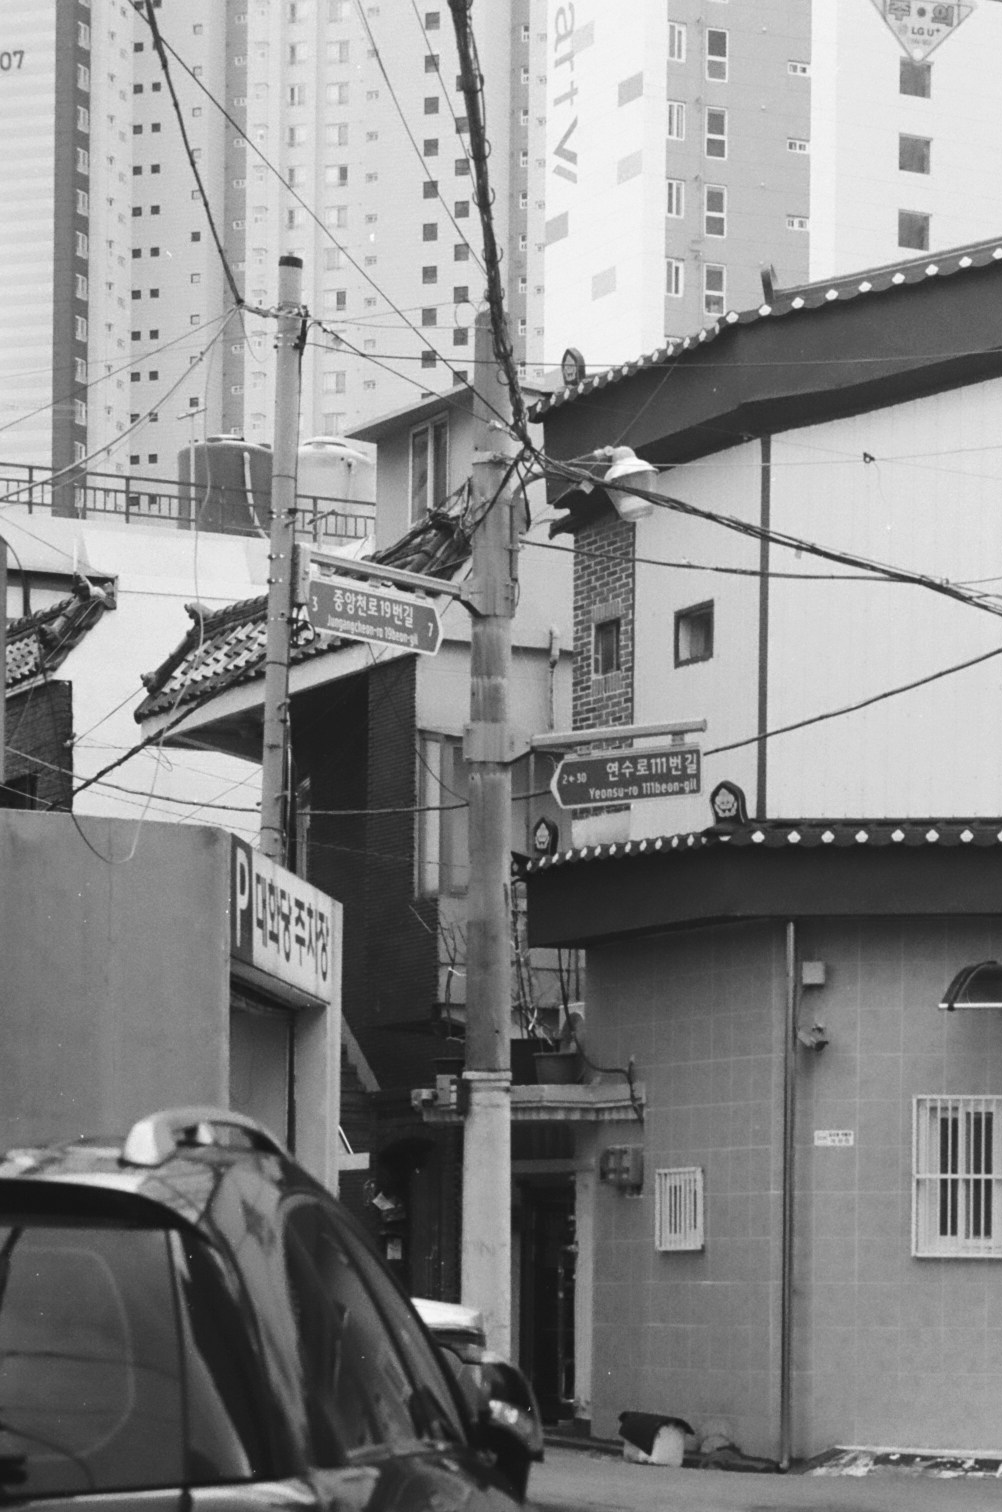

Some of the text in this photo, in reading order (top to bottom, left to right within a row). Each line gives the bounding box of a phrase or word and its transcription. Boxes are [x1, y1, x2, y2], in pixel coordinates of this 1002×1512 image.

[311, 595, 319, 612] 3
[333, 589, 414, 629] 중앙천로19번길
[427, 622, 434, 638] 7
[562, 772, 587, 784] 2 30
[606, 753, 697, 781] 연수로111번길
[589, 778, 697, 800] Yeonsu-ro 111beon-gil
[236, 847, 250, 947] P
